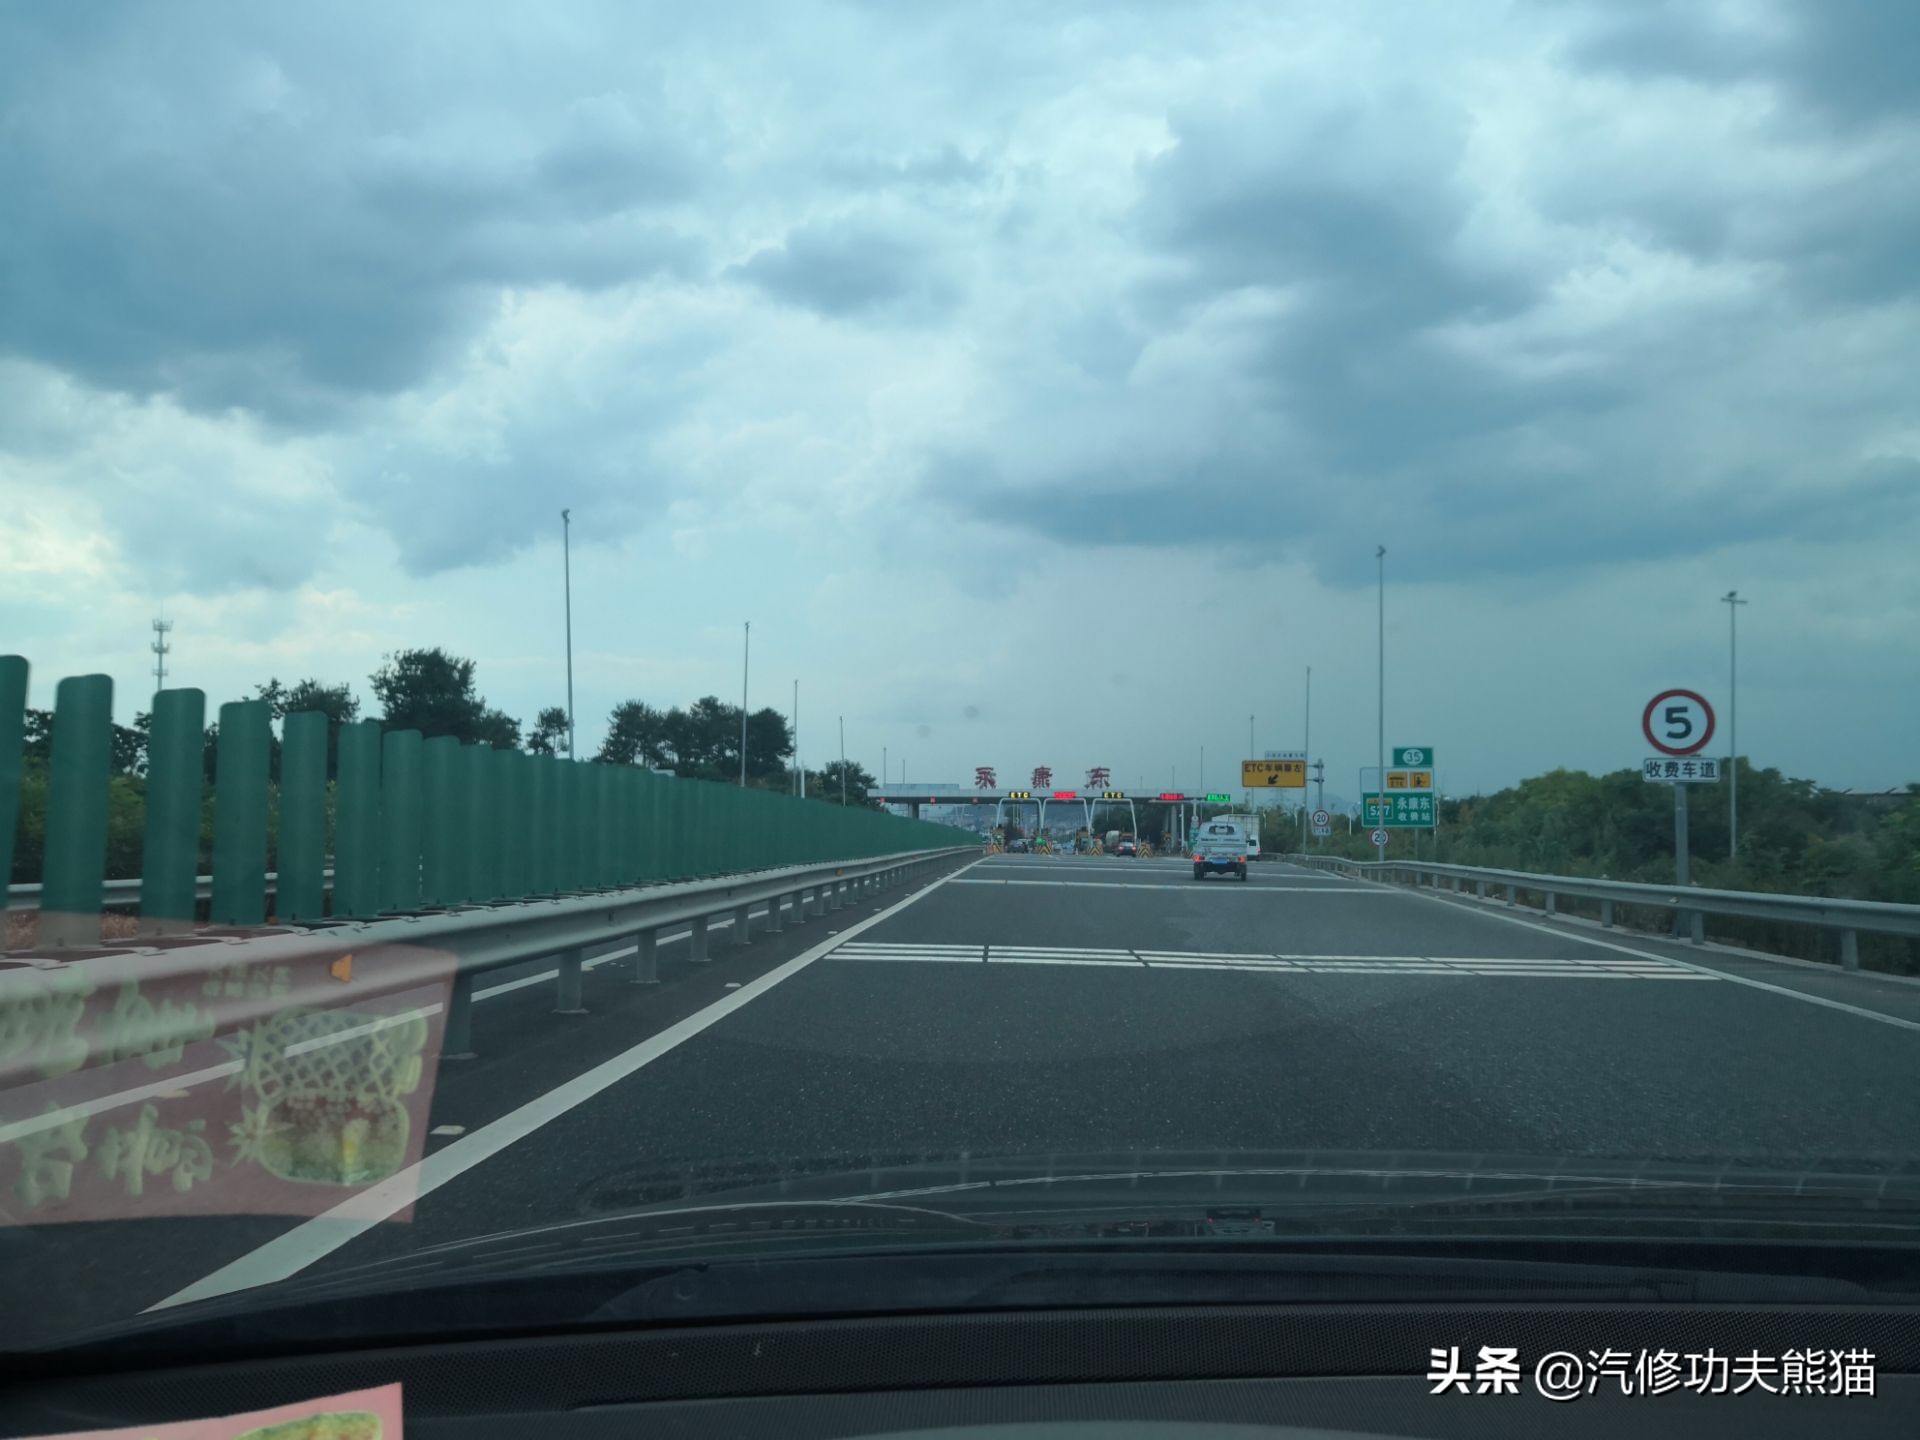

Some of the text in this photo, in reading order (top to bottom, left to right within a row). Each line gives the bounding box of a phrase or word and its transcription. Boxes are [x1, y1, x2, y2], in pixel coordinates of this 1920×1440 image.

[1665, 706, 1692, 739] 5
[1406, 751, 1421, 763] 35
[1646, 760, 1718, 779] 收费车道
[974, 765, 1111, 789] 永康东
[1010, 791, 1029, 799] ETC
[1103, 791, 1123, 799] ETC
[1316, 814, 1327, 823] 20
